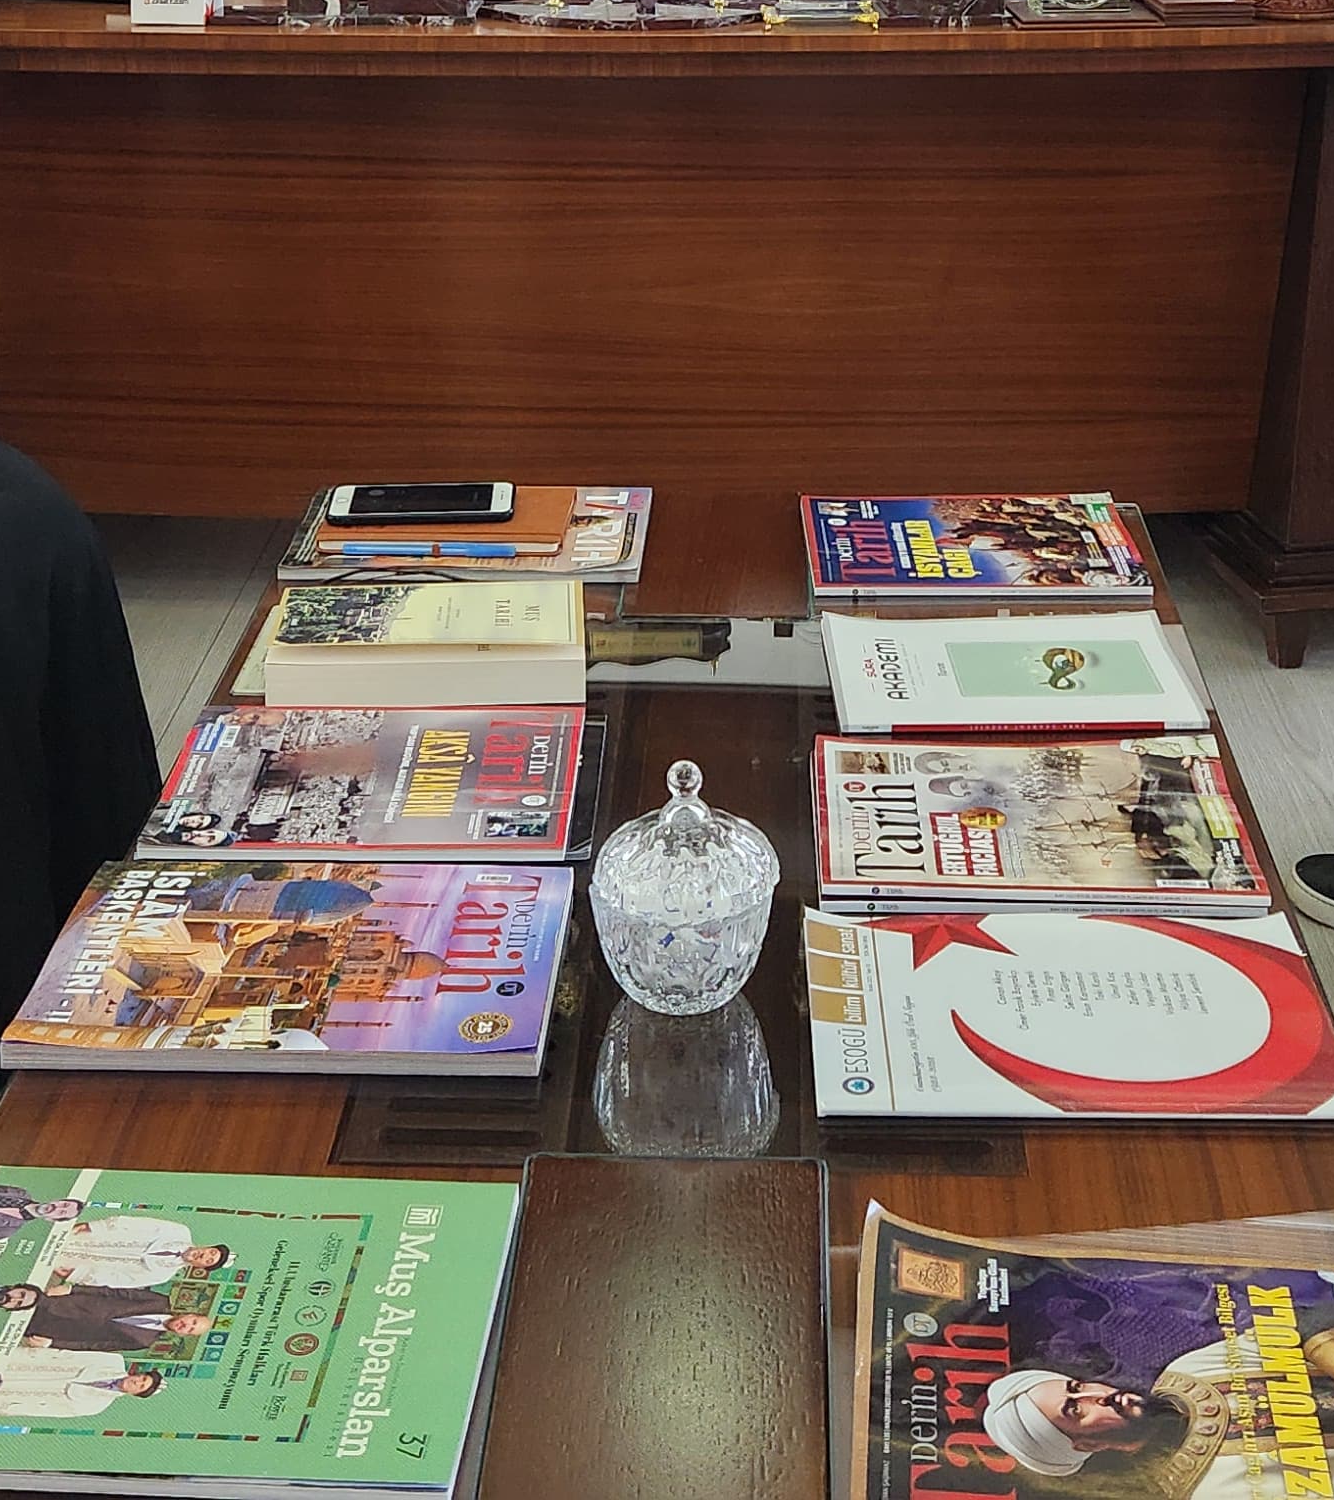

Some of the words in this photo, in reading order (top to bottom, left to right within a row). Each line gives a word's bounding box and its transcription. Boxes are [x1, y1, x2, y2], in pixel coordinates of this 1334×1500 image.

[830, 520, 898, 583] Tarih
[903, 519, 945, 579] İSYANLAR
[938, 548, 983, 579] ÇAĞI
[418, 729, 476, 764] AKSÂ
[527, 734, 554, 776] Derin
[401, 765, 464, 818] YANGINI
[845, 811, 871, 852] Derin
[846, 780, 927, 879] Tarih
[932, 813, 971, 875] ERTUĞRUL
[965, 828, 1002, 876] FACİAS
[125, 870, 208, 939] İSLÂM
[505, 903, 537, 949] Derin
[62, 869, 158, 995] BAŞKENTLERİ
[434, 875, 542, 997] Tarih
[836, 927, 858, 956] sanat
[839, 959, 862, 990] kültür
[842, 995, 864, 1023] bilim
[837, 1028, 870, 1074] ESOGÜ
[373, 1231, 437, 1298] Muş
[1210, 1283, 1238, 1325] Bilgesi
[335, 1302, 418, 1458] Alparslan
[900, 1382, 939, 1463] Derin
[1232, 1394, 1259, 1428] Aşan
[395, 1432, 429, 1460] 37
